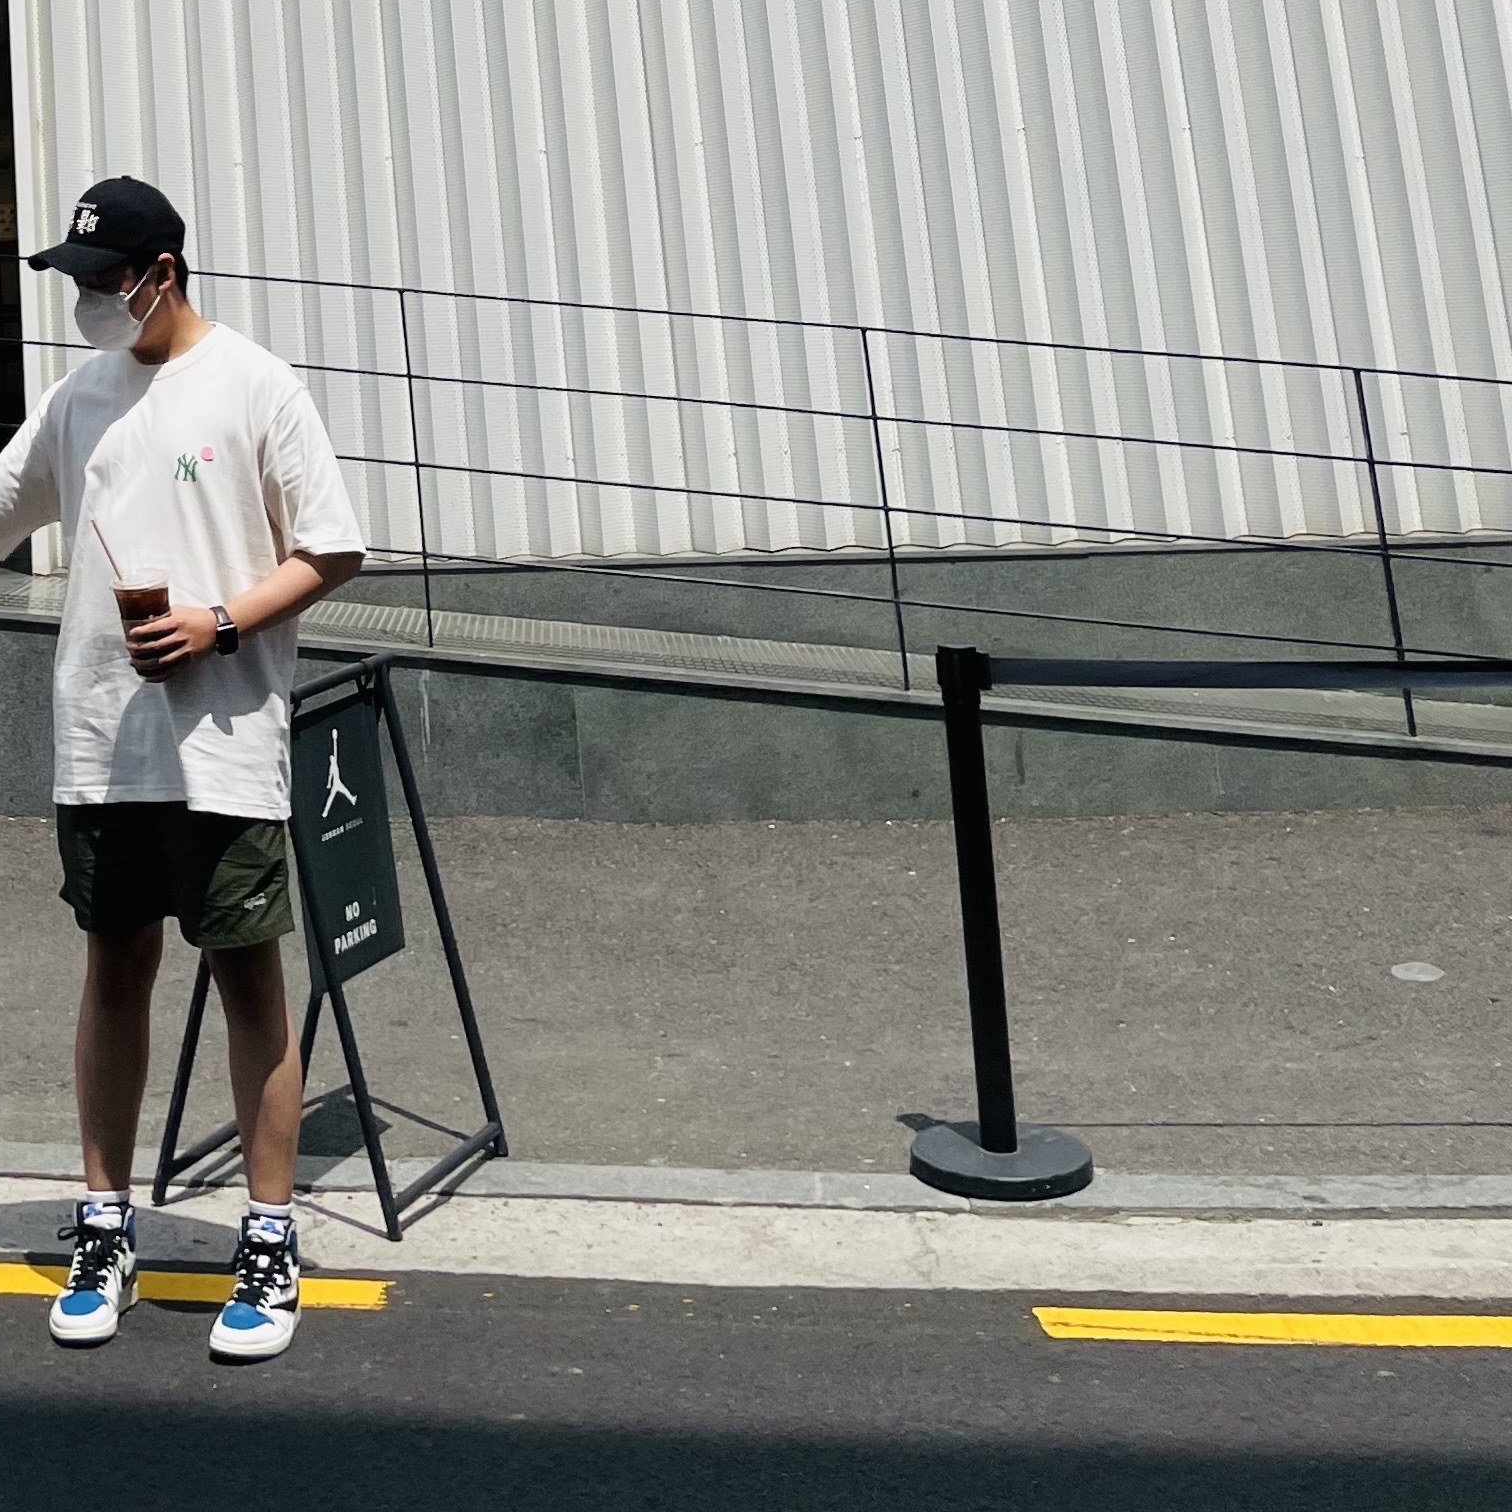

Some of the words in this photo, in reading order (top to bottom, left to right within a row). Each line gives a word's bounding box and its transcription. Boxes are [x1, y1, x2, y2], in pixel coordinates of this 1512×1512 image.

[174, 452, 198, 482] NY
[345, 901, 360, 921] NO
[334, 918, 377, 955] PARKING
